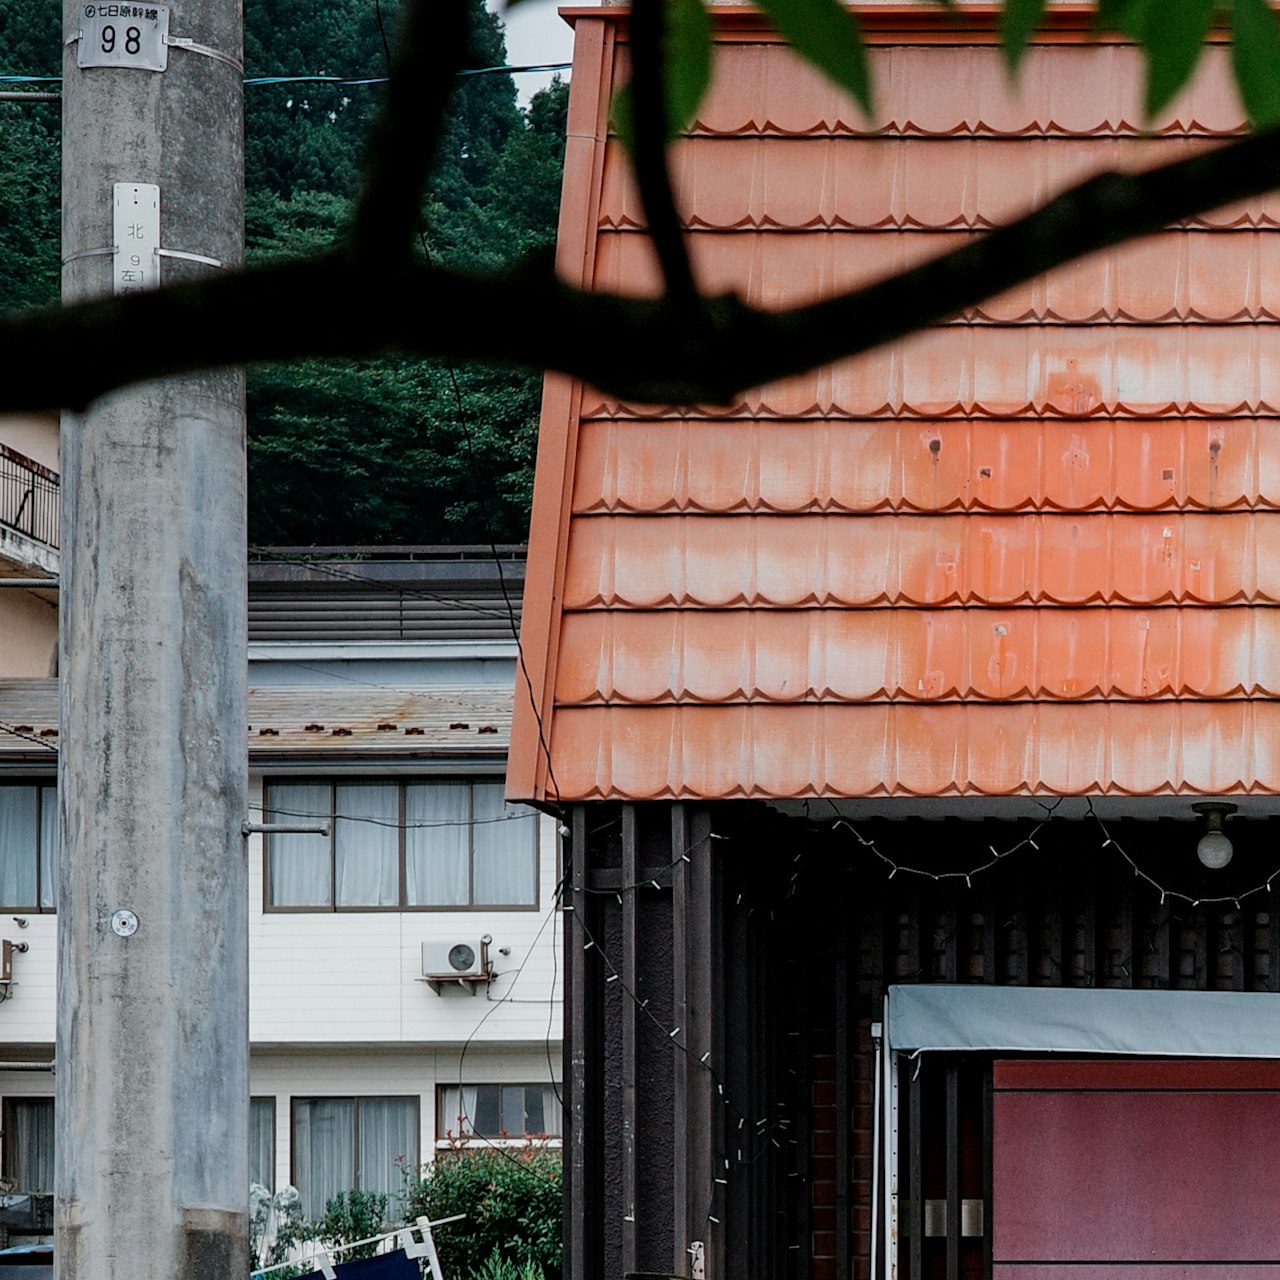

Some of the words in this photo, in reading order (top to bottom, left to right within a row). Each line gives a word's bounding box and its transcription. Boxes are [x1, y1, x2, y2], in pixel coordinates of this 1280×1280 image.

[98, 5, 158, 21] 七日原幹線
[127, 223, 144, 240] 北
[130, 254, 140, 267] 9
